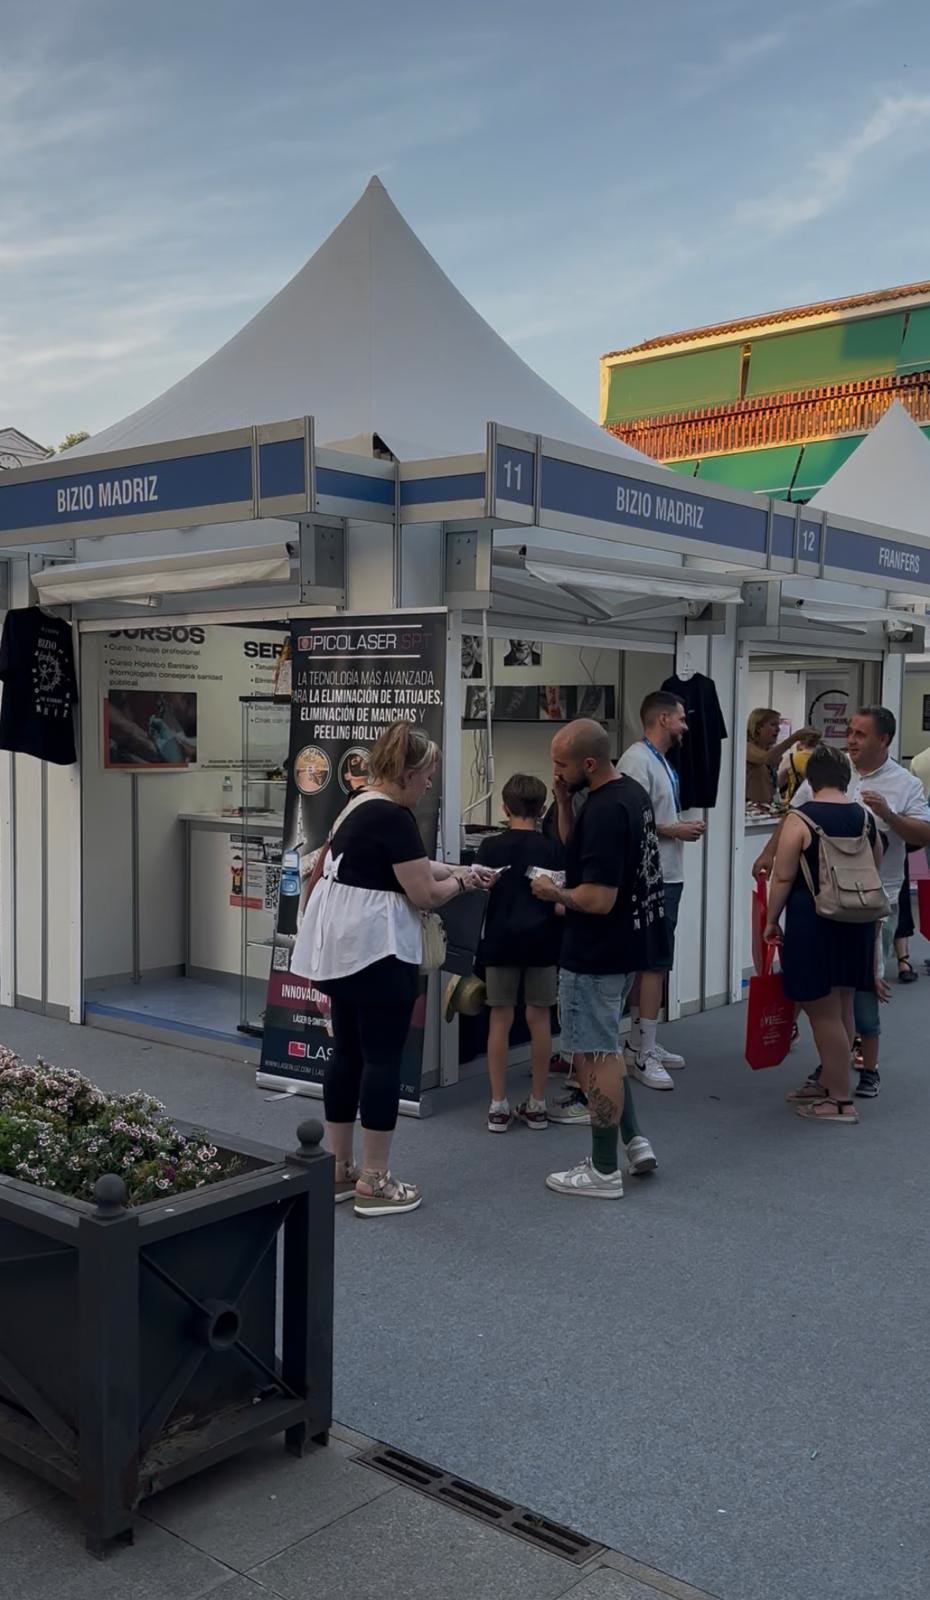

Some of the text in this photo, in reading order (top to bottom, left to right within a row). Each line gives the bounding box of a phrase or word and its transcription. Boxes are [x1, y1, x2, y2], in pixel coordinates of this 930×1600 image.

[503, 460, 523, 491] 11
[57, 475, 159, 513] BIZIO MADRIZ
[616, 486, 704, 529] BIZIO MADRIZ
[802, 530, 816, 552] 12
[878, 547, 920, 574] FRANFERS
[109, 643, 132, 651] Curso
[312, 633, 398, 651] PICOLASER
[109, 659, 133, 667] Curso
[298, 668, 435, 686] LA TECNOLOGÍA MÁS AVANZADA
[309, 689, 320, 704] LA
[321, 686, 379, 704] ELIMINACIÓN
[380, 689, 392, 704] DE
[394, 689, 444, 706] TATUAJES,
[300, 704, 355, 722] ELIMINACIÓN
[356, 707, 369, 722] DE
[371, 707, 417, 723] MANCHAS
[419, 708, 426, 723] Y
[314, 725, 351, 740] PEELING
